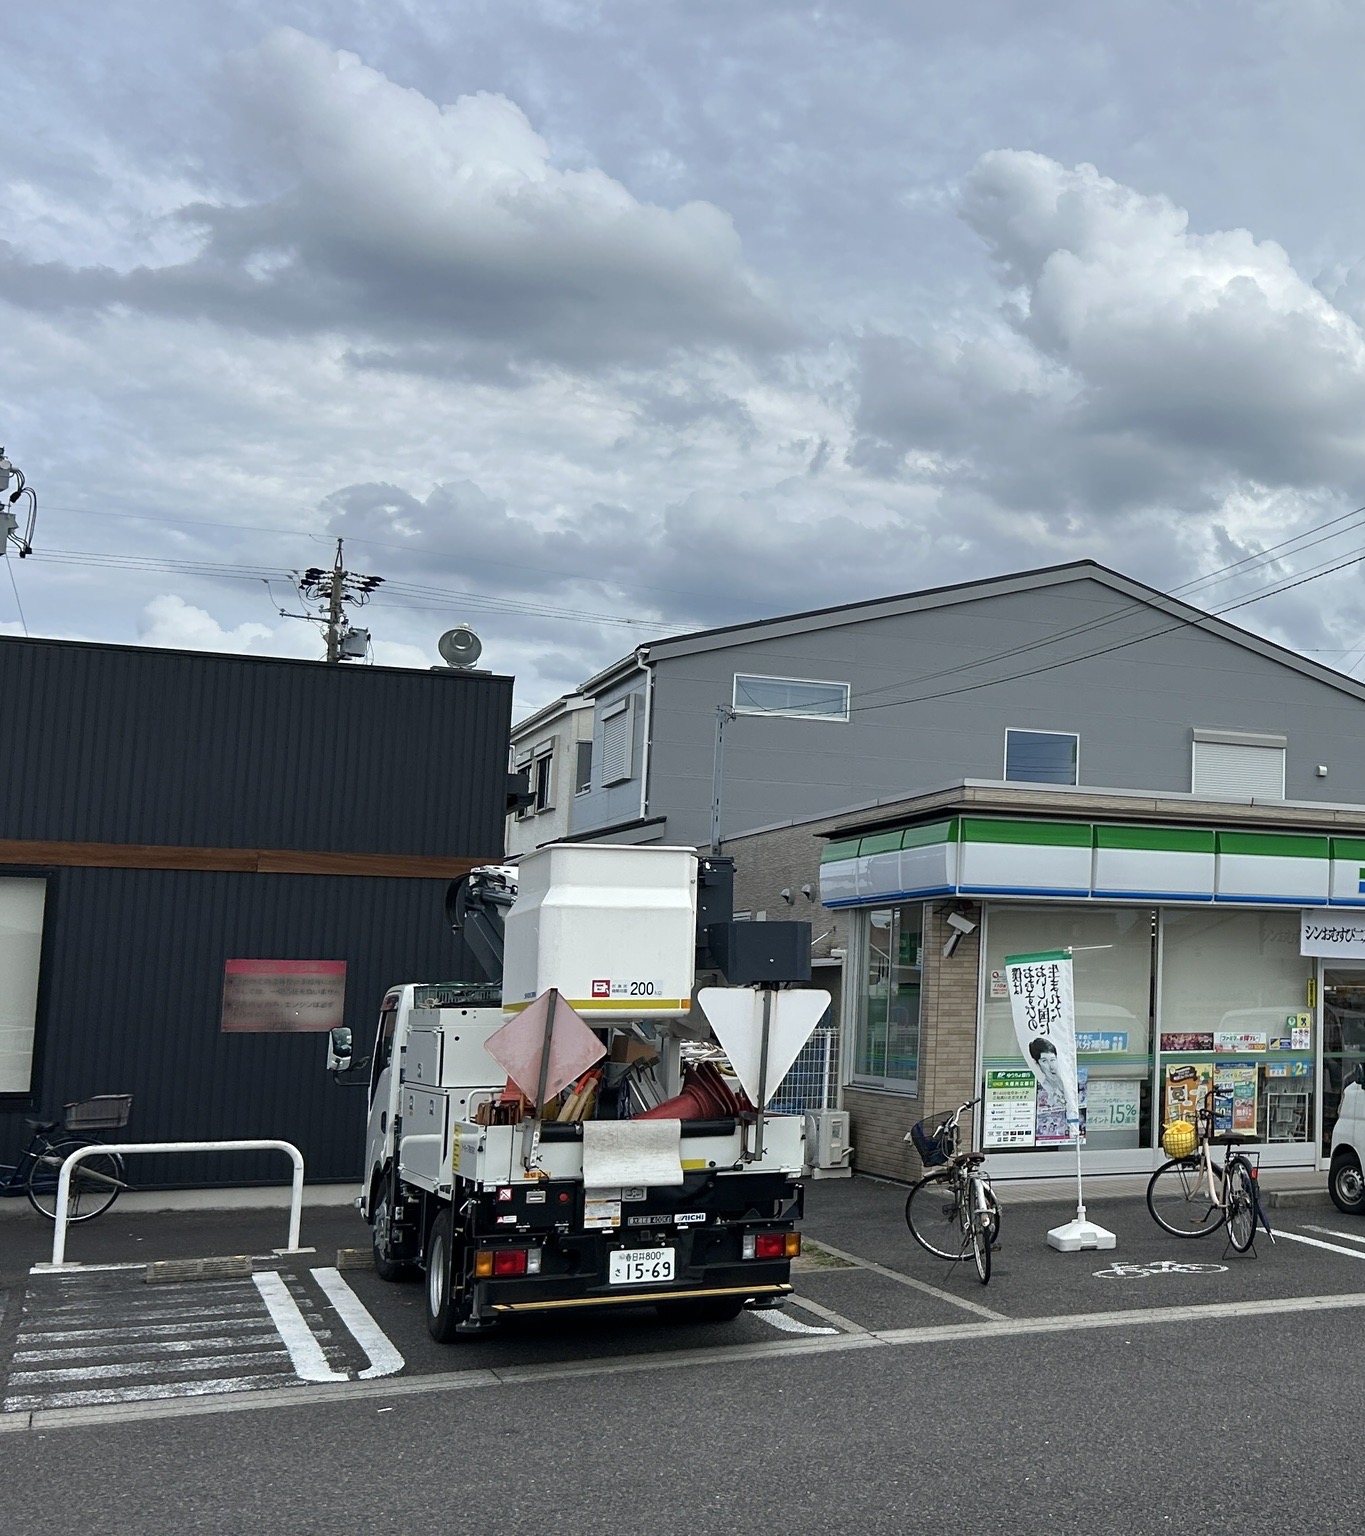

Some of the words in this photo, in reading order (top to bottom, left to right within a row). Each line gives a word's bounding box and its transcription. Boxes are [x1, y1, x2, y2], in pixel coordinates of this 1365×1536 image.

[630, 981, 654, 996] 200
[615, 1268, 621, 1277] さ
[626, 1261, 671, 1280] 15-69
